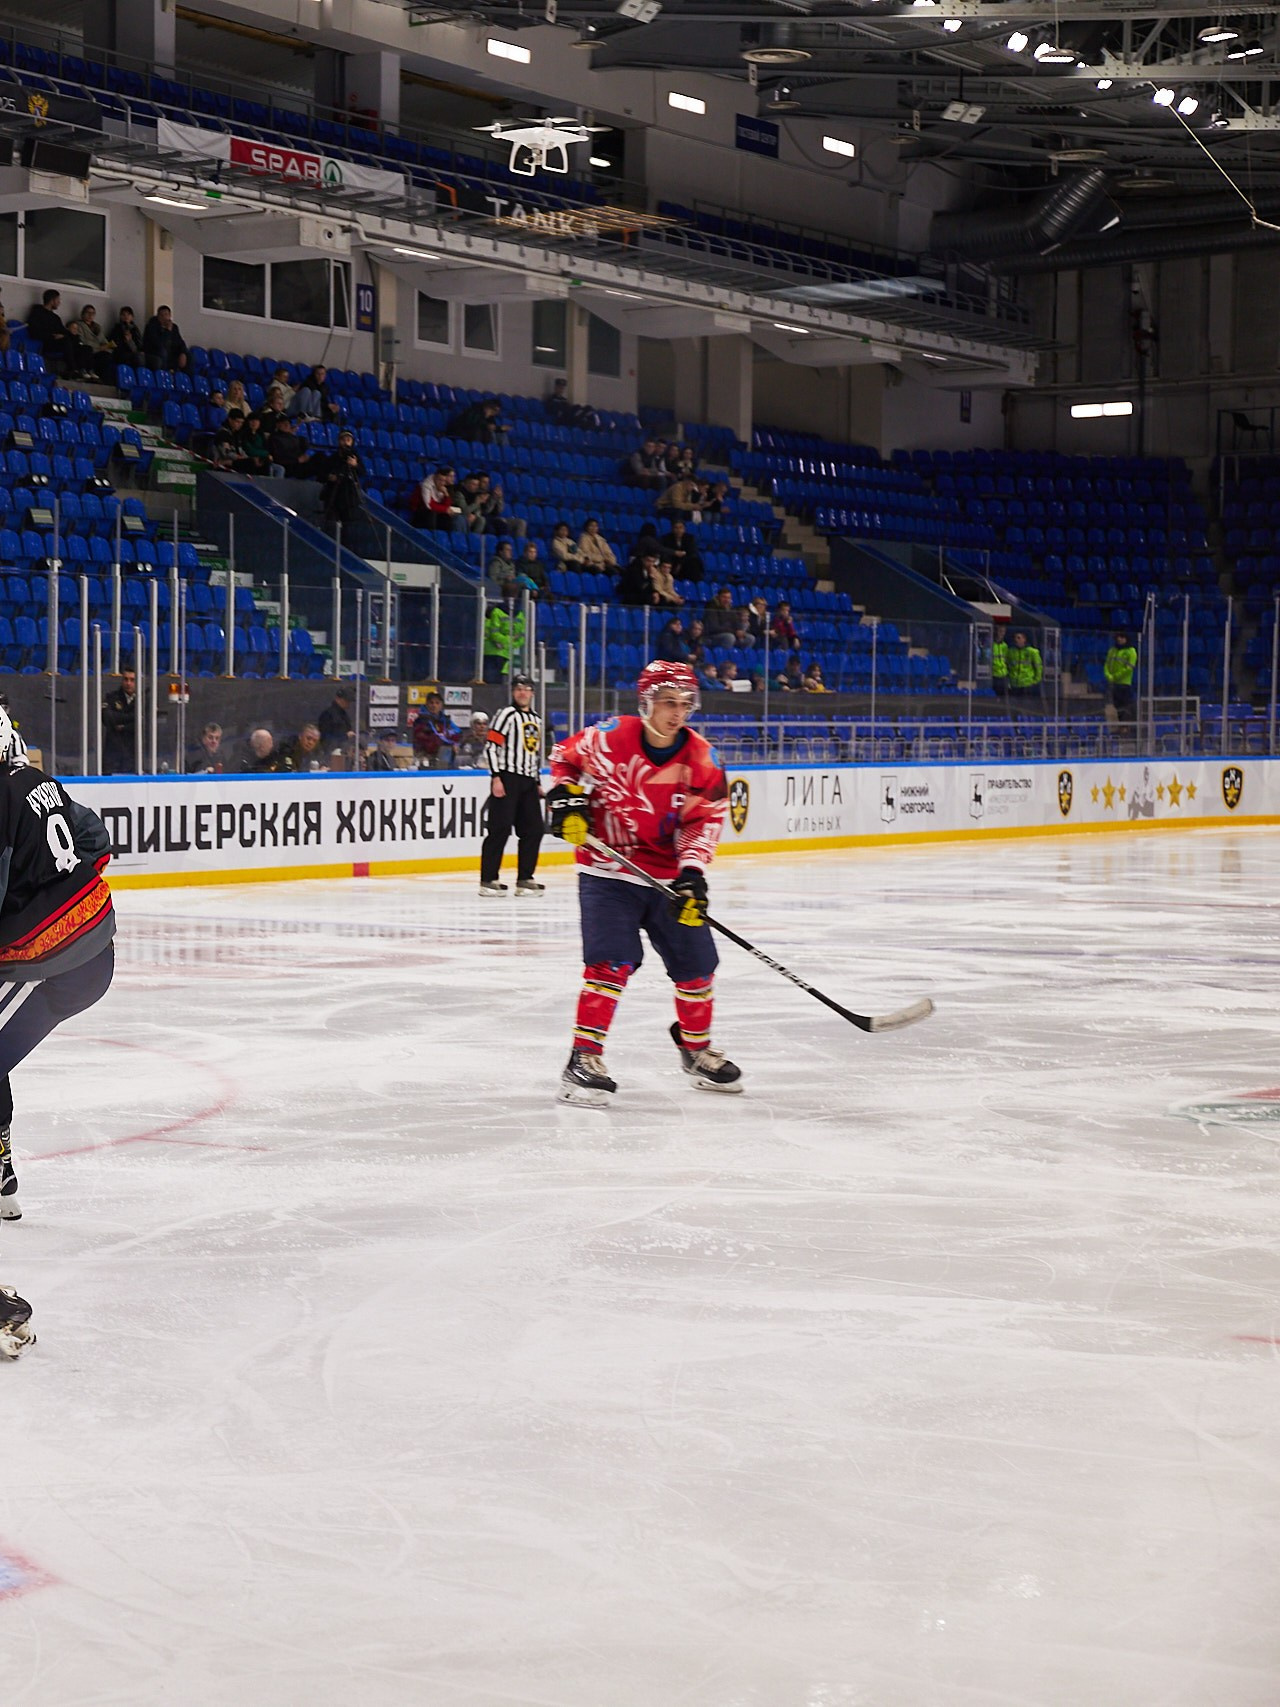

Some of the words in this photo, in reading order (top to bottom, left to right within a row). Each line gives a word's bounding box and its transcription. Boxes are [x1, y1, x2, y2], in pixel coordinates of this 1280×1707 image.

[251, 149, 320, 179] SPAR
[359, 290, 373, 312] 10
[784, 776, 843, 806] ЛИГА
[900, 783, 929, 796] НИЖНИЙ
[987, 778, 1032, 789] ПРАВИТЕЛЬСТВО
[900, 801, 935, 814] НОВГОРОД
[101, 802, 321, 859] ФИЦЕРСКАЯ
[336, 784, 493, 843] ХОККЕЙНА
[787, 815, 841, 833] СИЛЬНЫХ
[47, 813, 81, 873] 8
